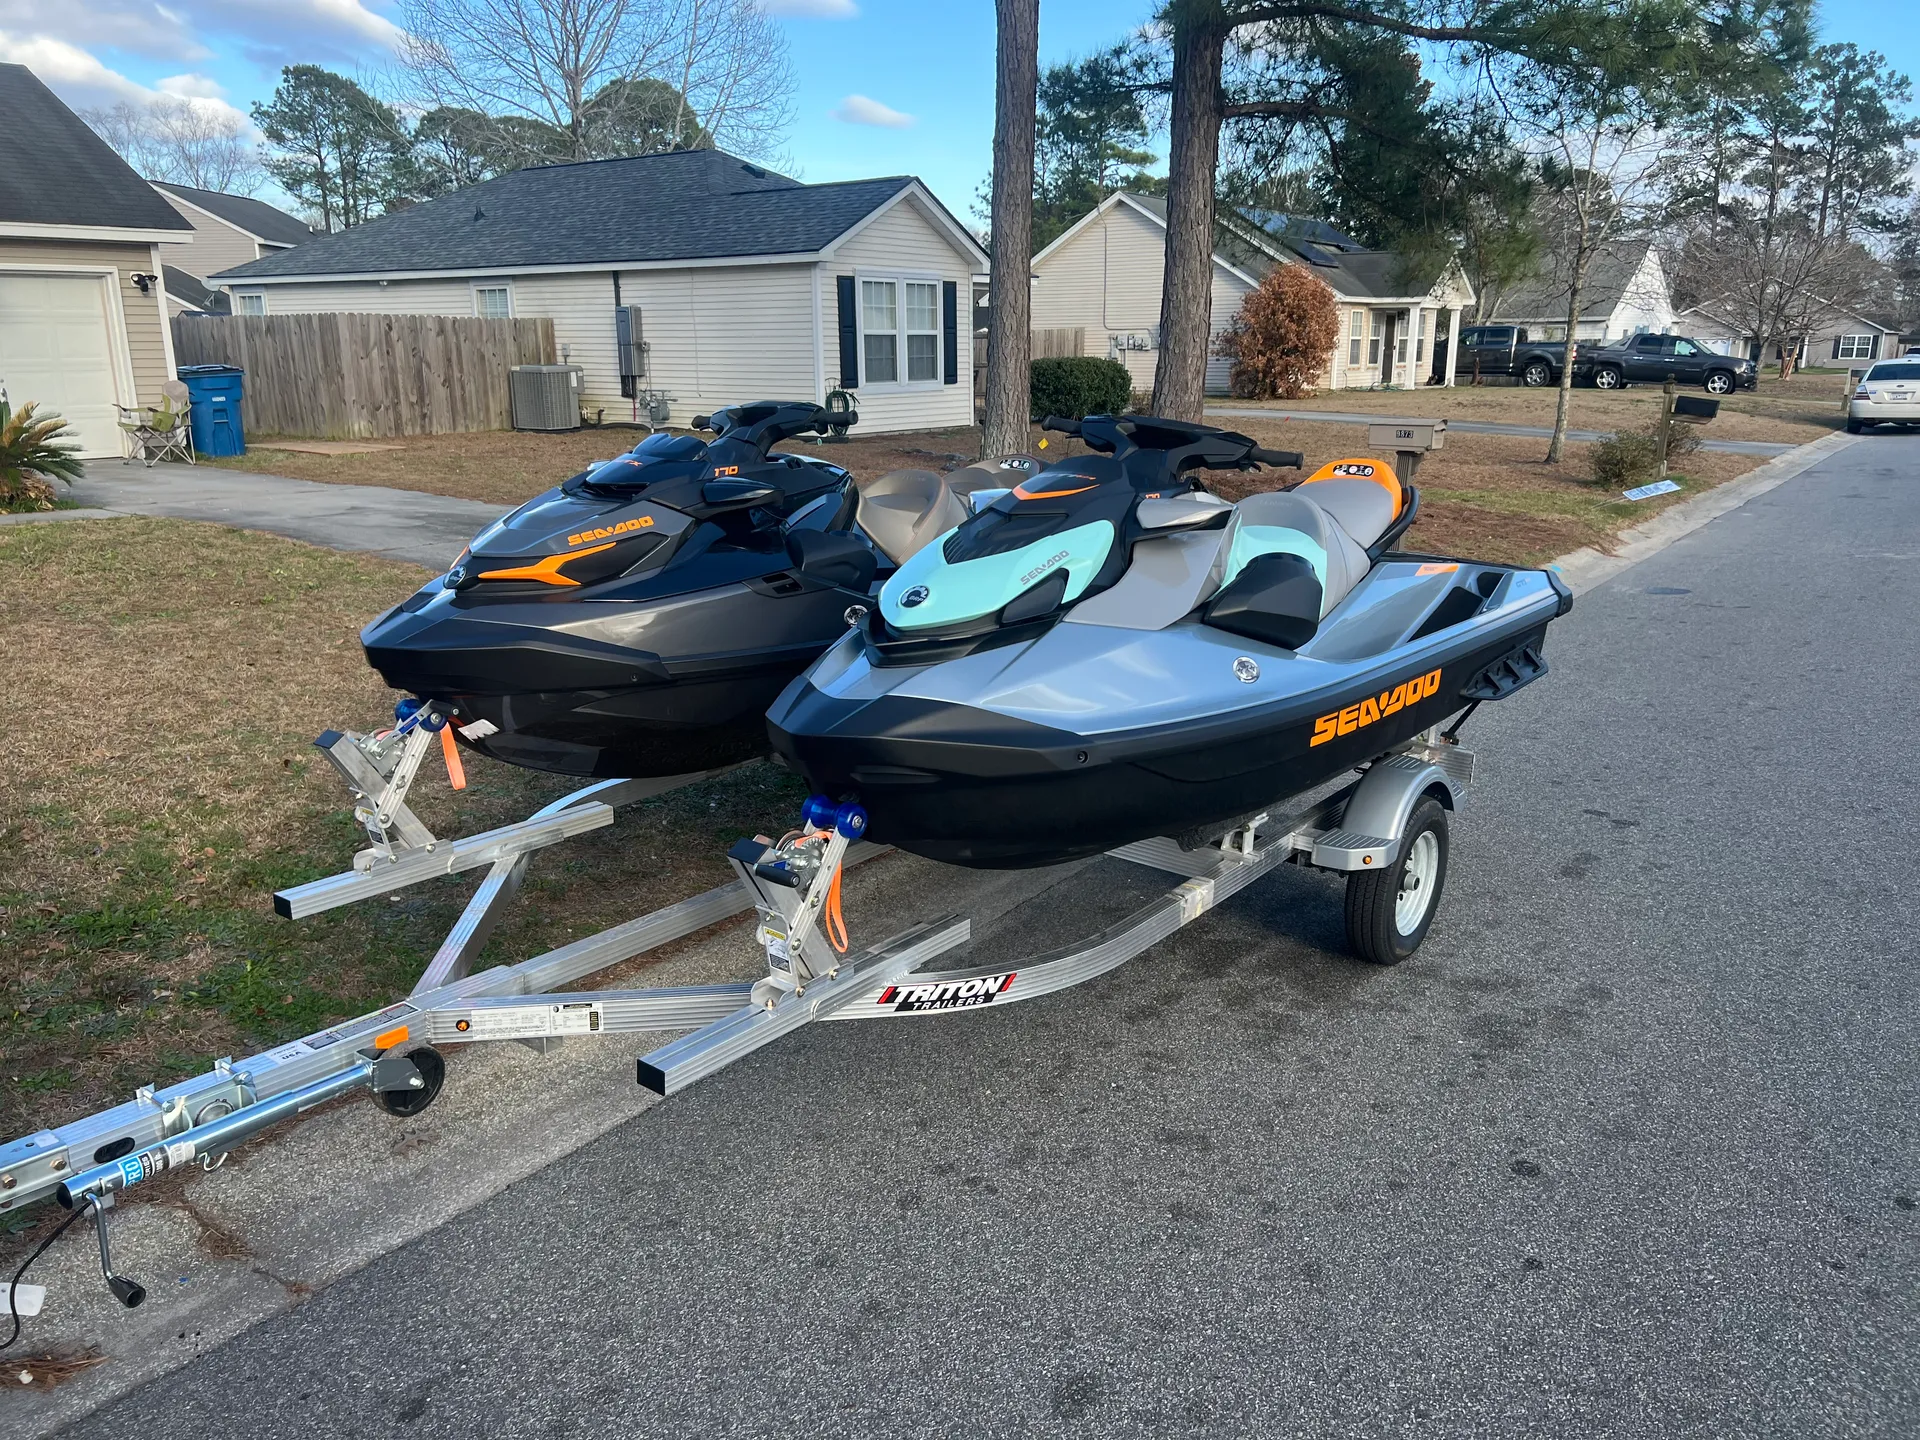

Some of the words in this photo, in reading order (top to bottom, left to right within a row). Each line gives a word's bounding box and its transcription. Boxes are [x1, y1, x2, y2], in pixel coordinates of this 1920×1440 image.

[714, 465, 739, 477] 170
[893, 975, 1007, 1003] TRITON
[912, 995, 985, 1011] TRAILERS
